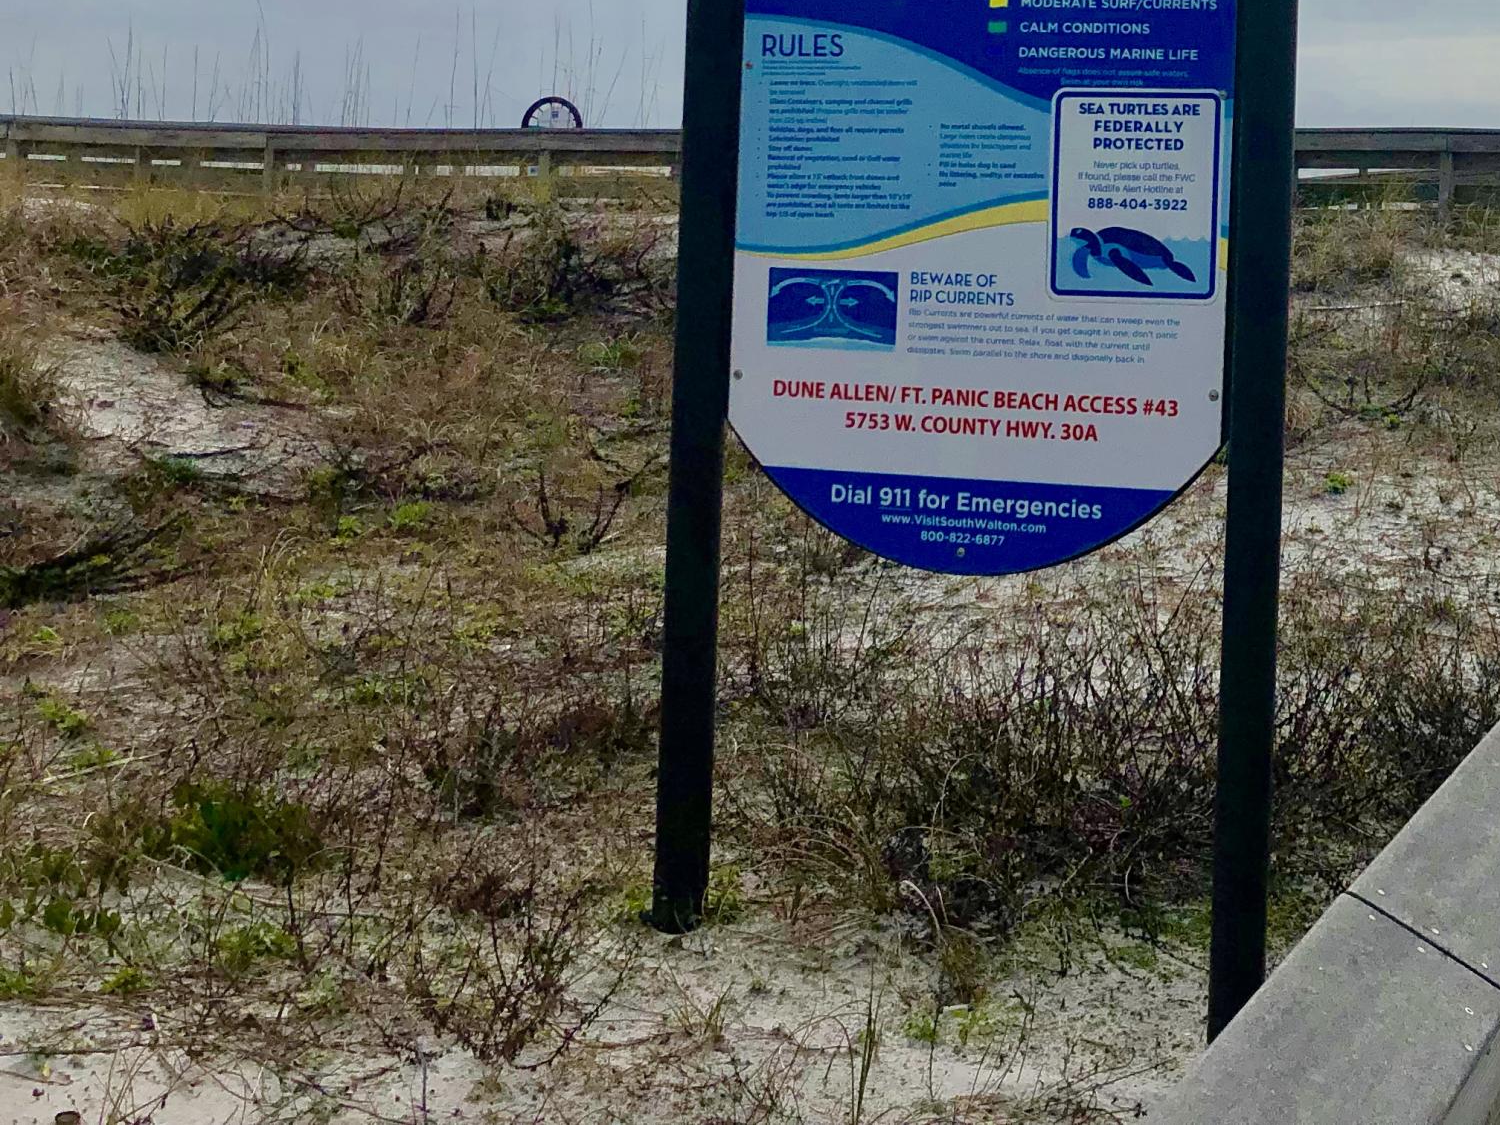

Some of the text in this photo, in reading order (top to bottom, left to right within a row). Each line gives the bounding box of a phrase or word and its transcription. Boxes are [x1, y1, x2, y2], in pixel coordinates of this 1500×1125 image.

[1020, 22, 1150, 34] CALM CONDITIONS
[762, 34, 844, 57] RULES
[1018, 47, 1199, 60] DANGEROUS MARINE LIFE
[1079, 103, 1201, 115] SEA TURTLES ARE
[1094, 120, 1184, 133] FEDERALLY
[1093, 138, 1184, 151] PROTECTED
[1093, 161, 1117, 170] Never
[1119, 161, 1137, 170] pick
[1139, 162, 1151, 171] up
[1113, 173, 1141, 182] please
[1142, 173, 1158, 181] call
[1158, 174, 1173, 182] the
[1175, 174, 1196, 182] FWC
[1089, 184, 1184, 194] Wildlife Alert Hotline at
[1088, 197, 1188, 211] 888-404-3922
[910, 271, 997, 287] BEWARE OF
[909, 289, 1015, 306] RIP CURRENTS
[773, 380, 1179, 417] DUNE ALLEN/ FT. PANIC BEACH ACCESS #43
[844, 412, 1098, 442] 5753 W. COUNTY HWY. 30A
[831, 483, 1103, 520] Dial 911 for Emergencies
[881, 512, 1047, 534] www.VisitSouthWalton.com
[920, 530, 1005, 547] 800-822-6877
